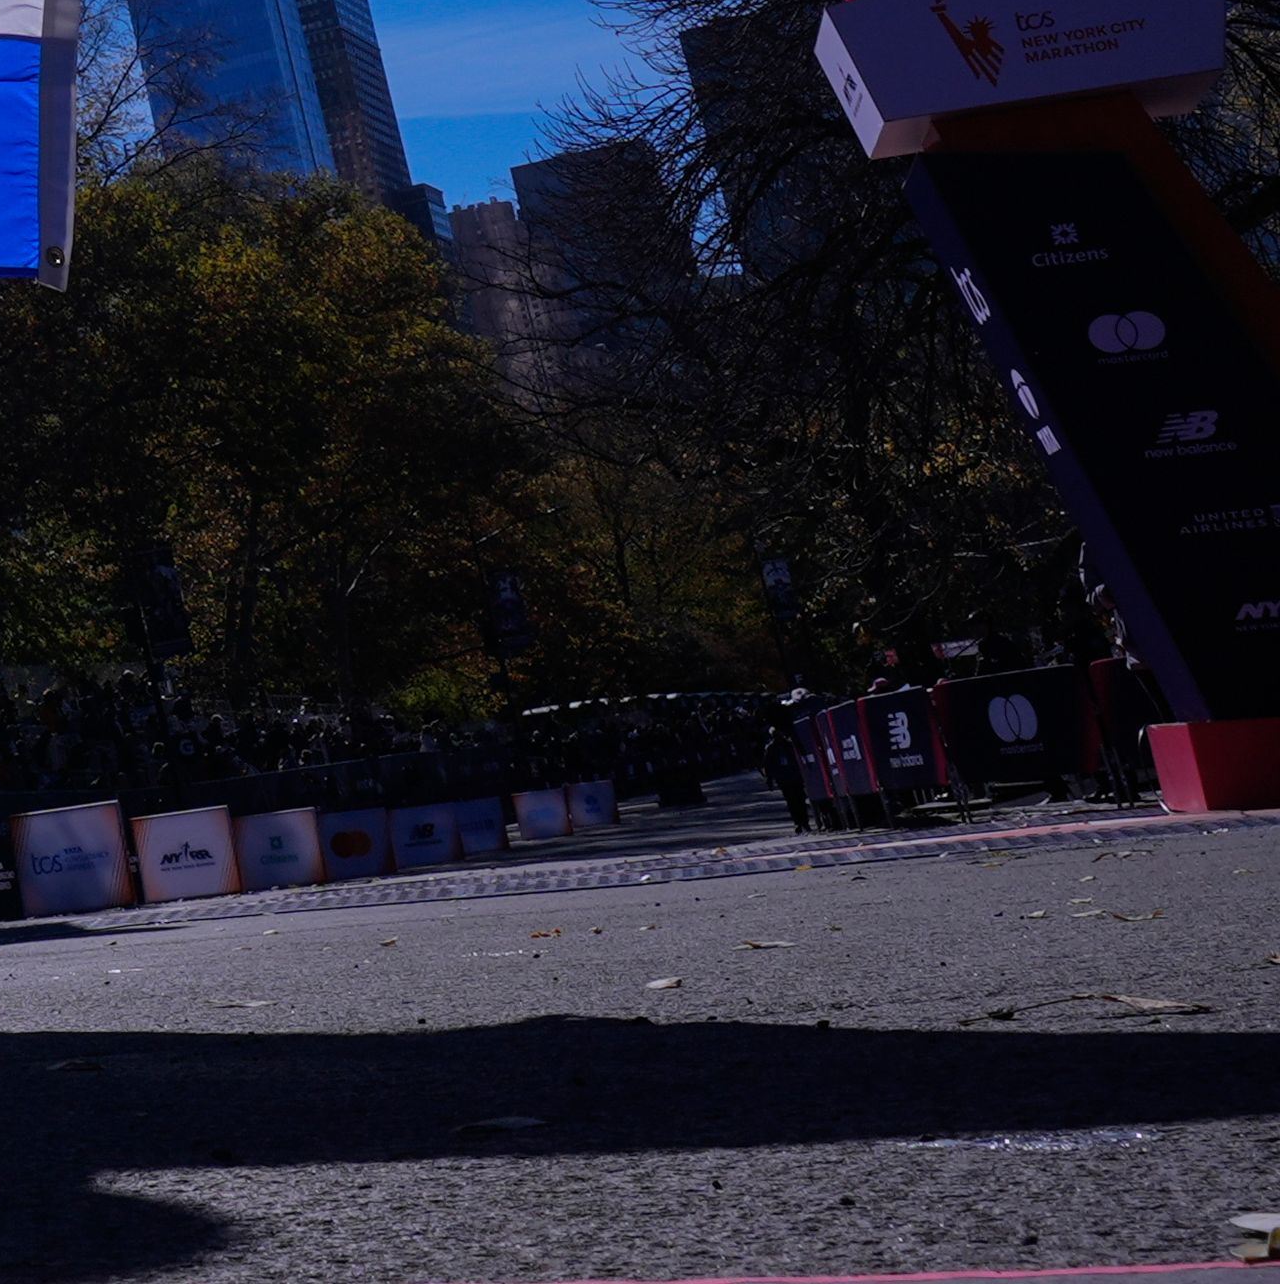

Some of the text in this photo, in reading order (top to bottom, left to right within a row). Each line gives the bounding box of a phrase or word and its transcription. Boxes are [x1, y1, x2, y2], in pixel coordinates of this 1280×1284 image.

[1015, 10, 1055, 31] tcs
[1021, 18, 1146, 49] NEW YORK CITY
[1025, 38, 1120, 63] MARATHON
[1031, 246, 1110, 268] Citizens
[1143, 440, 1239, 460] new balance
[1193, 508, 1265, 523] UNITED
[1178, 519, 1269, 536] AIRLINES
[31, 853, 63, 875] tcs
